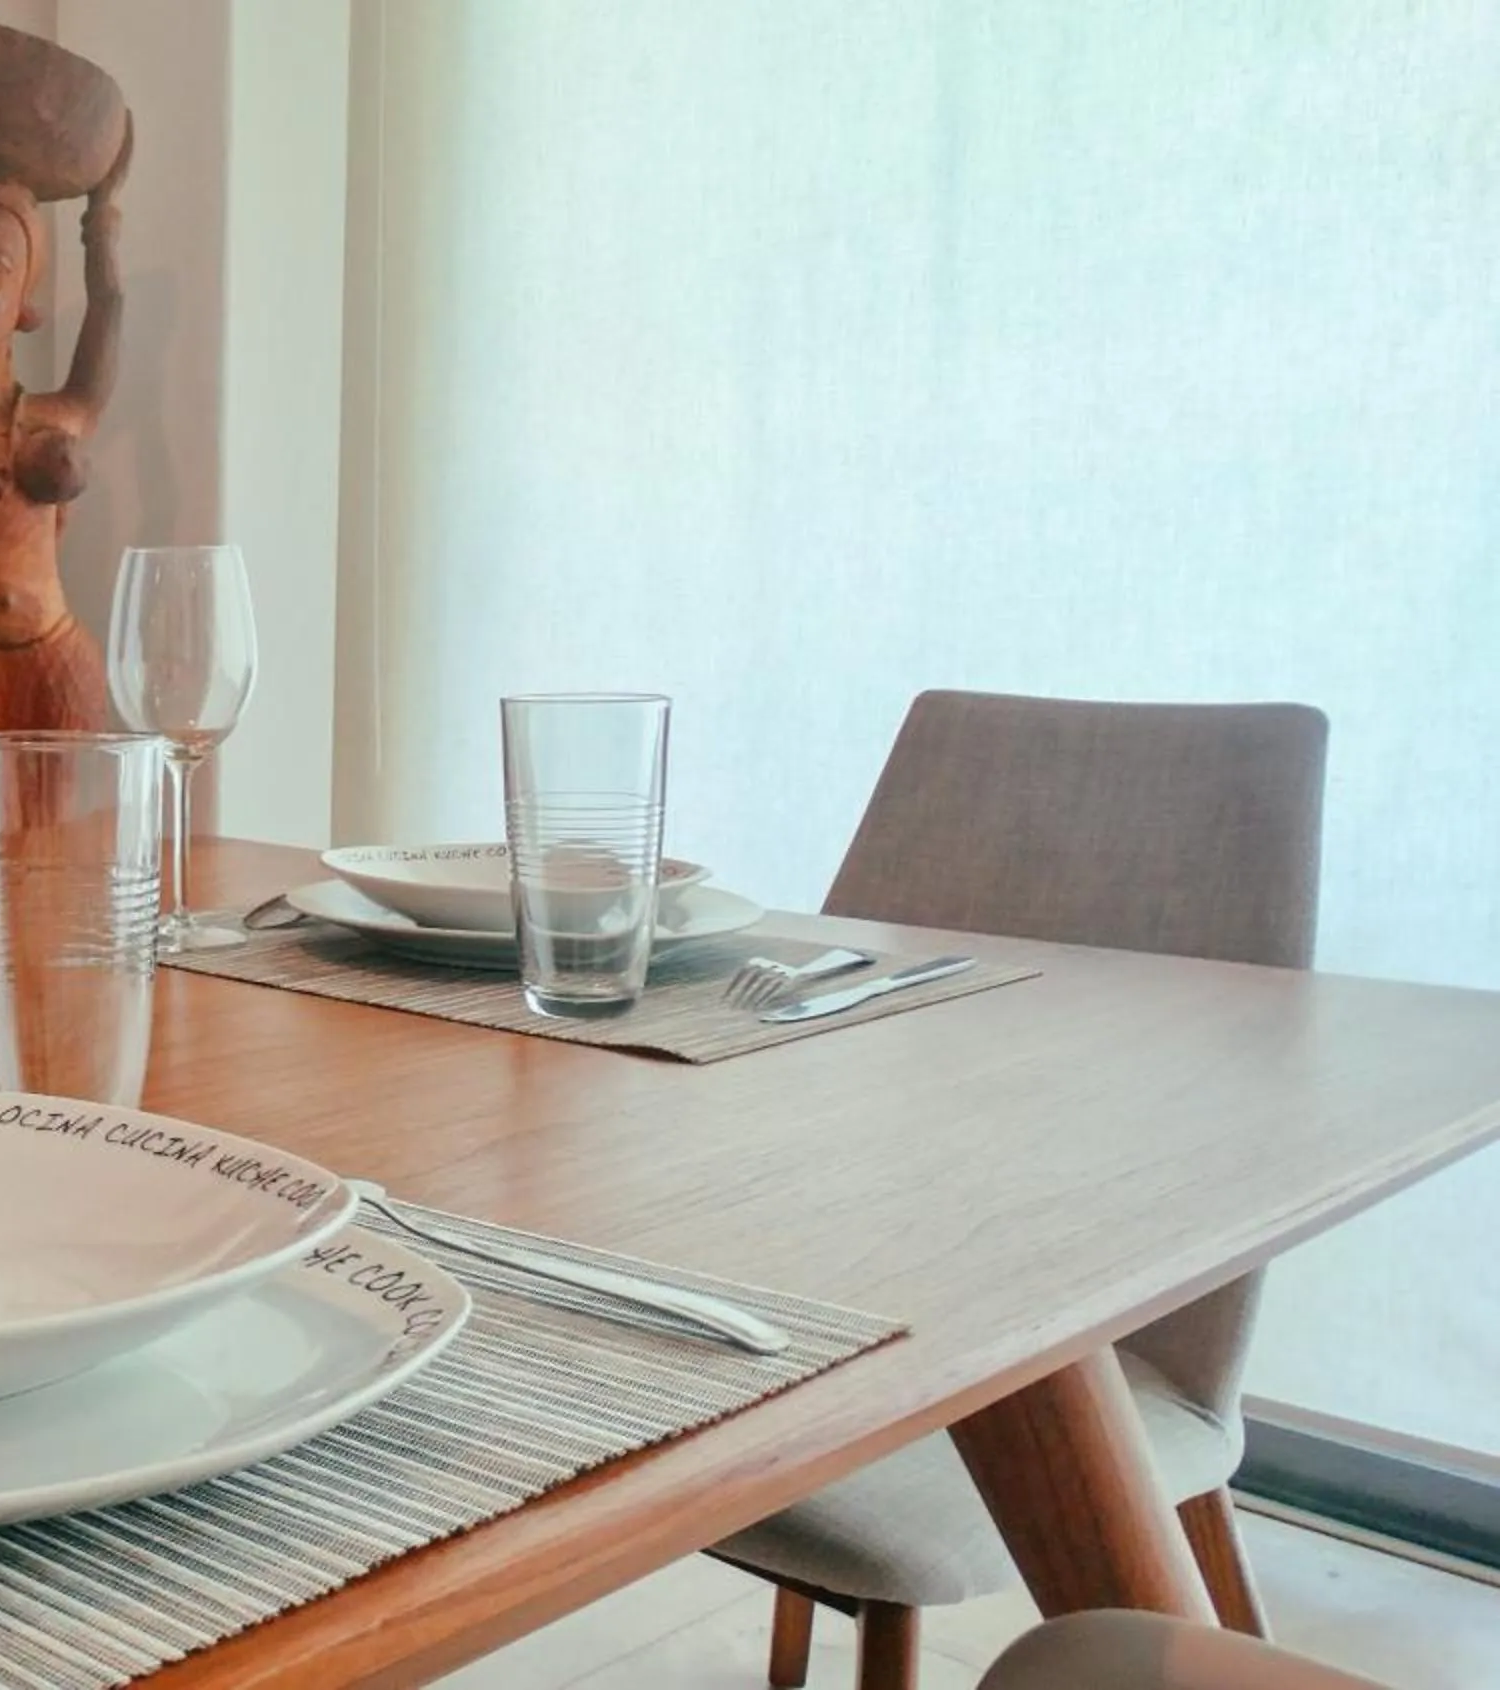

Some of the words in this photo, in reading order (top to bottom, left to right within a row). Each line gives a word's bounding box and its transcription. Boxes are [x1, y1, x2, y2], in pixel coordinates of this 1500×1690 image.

[486, 846, 507, 858] CO
[104, 1123, 217, 1169] CUCINA
[211, 1154, 290, 1192] KUCHE
[348, 1263, 434, 1312] COOK
